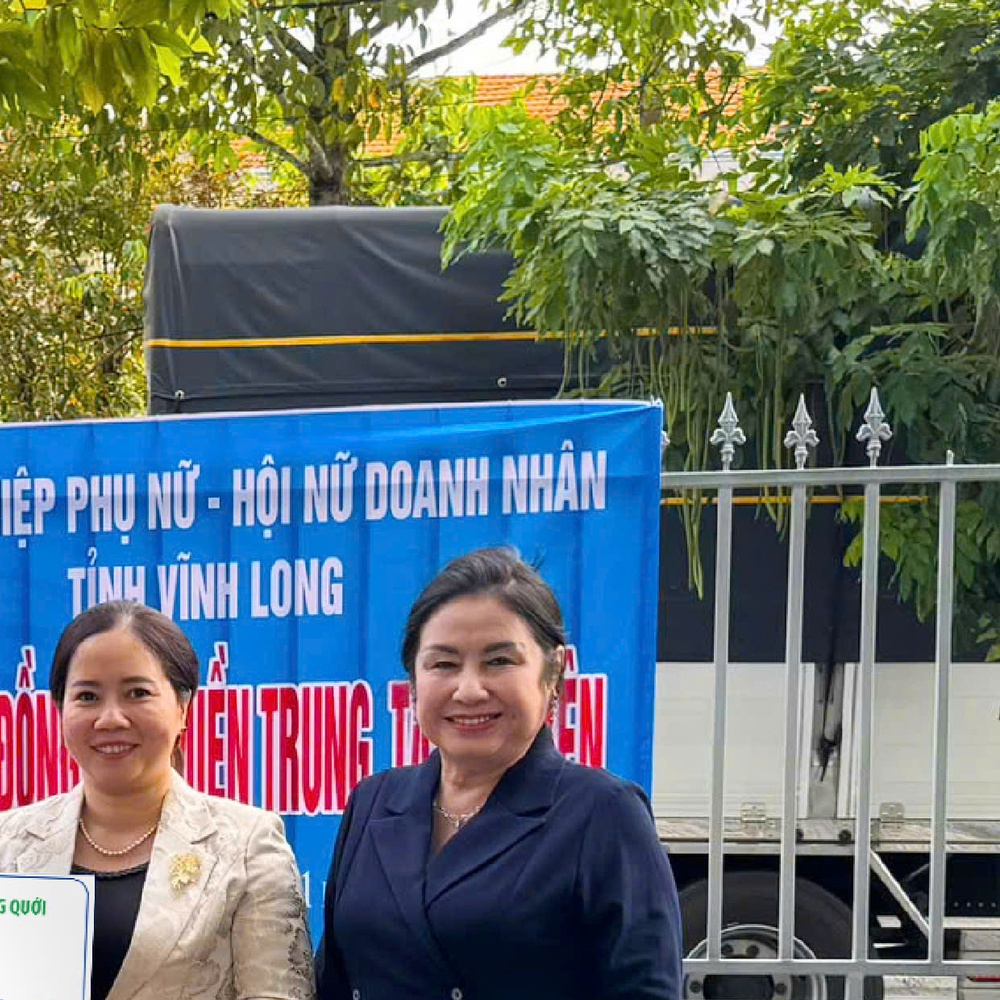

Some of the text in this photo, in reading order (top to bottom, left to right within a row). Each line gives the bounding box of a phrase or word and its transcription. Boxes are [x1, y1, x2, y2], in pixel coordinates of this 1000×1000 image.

[66, 474, 135, 545] PHỤ
[148, 460, 200, 530] NỮ
[208, 497, 221, 509] -
[232, 454, 291, 539] HỘI
[303, 450, 358, 524] NỮ
[366, 456, 490, 521] DOANH
[502, 439, 608, 514] NHÂN
[67, 547, 343, 620] TỈNH VĨNH LONG
[257, 681, 373, 816] TRUNG
[9, 897, 47, 917] QUỚI
